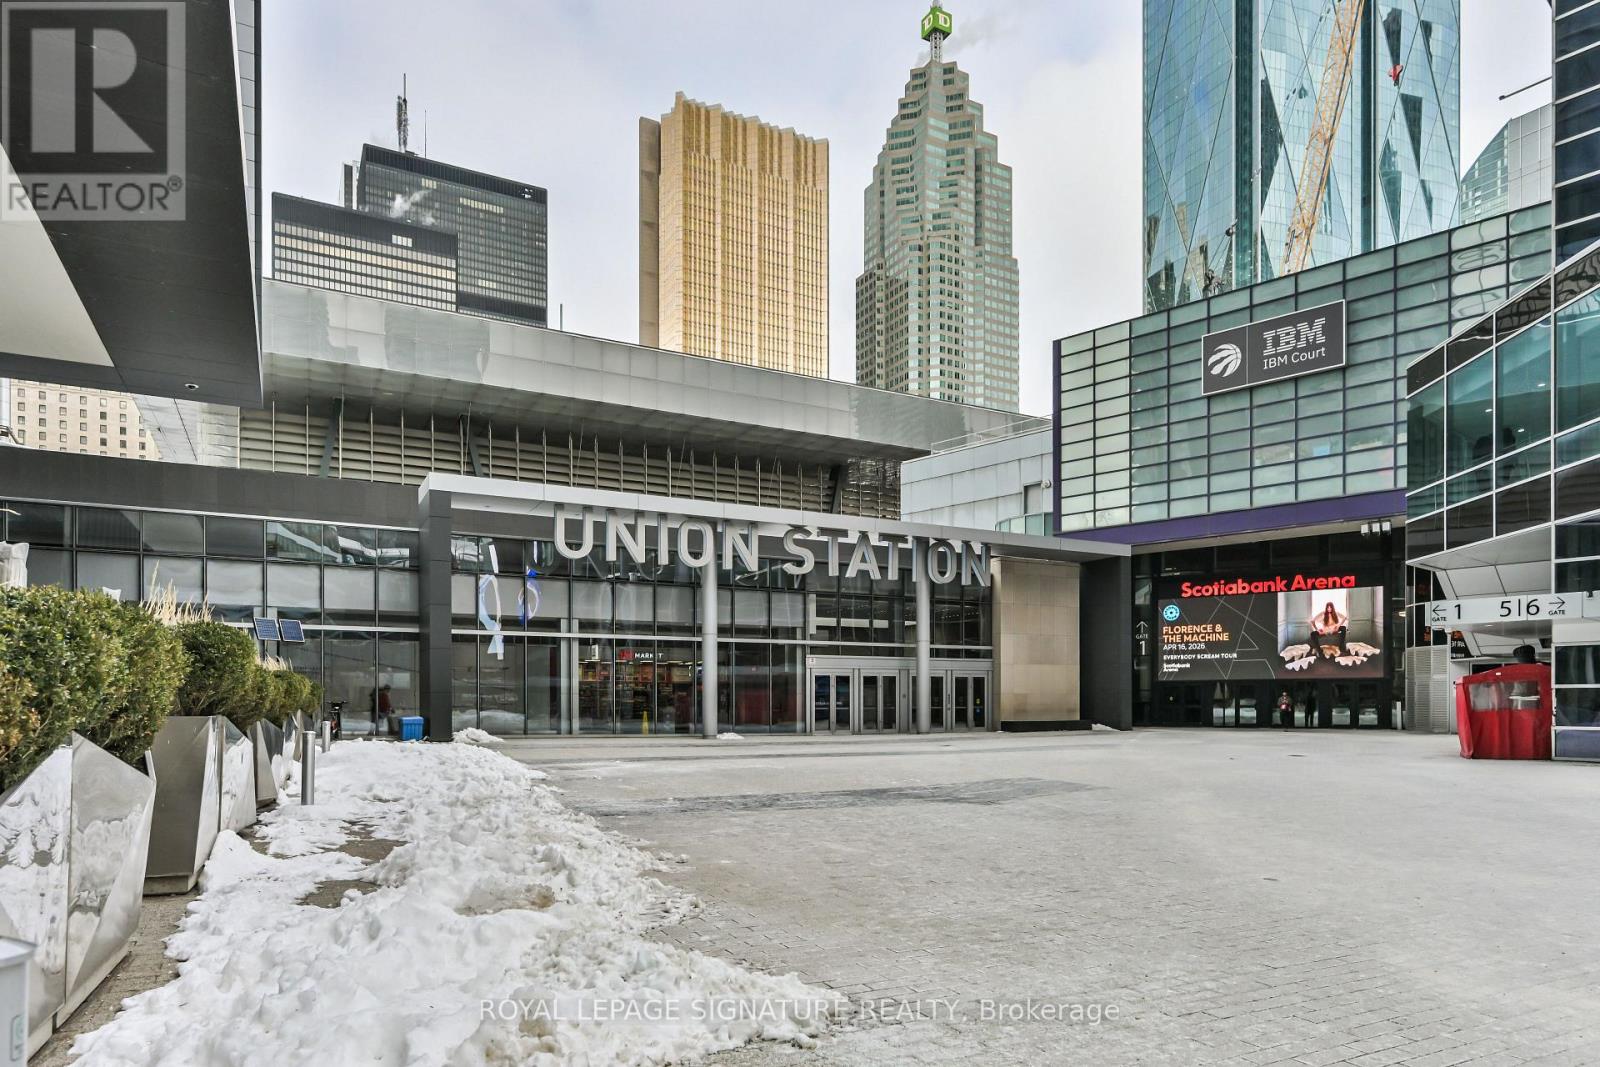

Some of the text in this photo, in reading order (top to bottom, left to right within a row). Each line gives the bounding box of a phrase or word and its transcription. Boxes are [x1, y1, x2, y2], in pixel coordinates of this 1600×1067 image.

[936, 11, 950, 27] TD
[1263, 317, 1326, 356] IBM
[1263, 346, 1326, 370] IBM Court
[554, 503, 992, 587] UNION STATION
[1181, 574, 1356, 598] Scotiabank Arena
[1454, 604, 1462, 620] 1
[1162, 623, 1223, 635] FLORENCE &
[1162, 632, 1230, 643] THE MACHINE
[1139, 640, 1146, 656] 1
